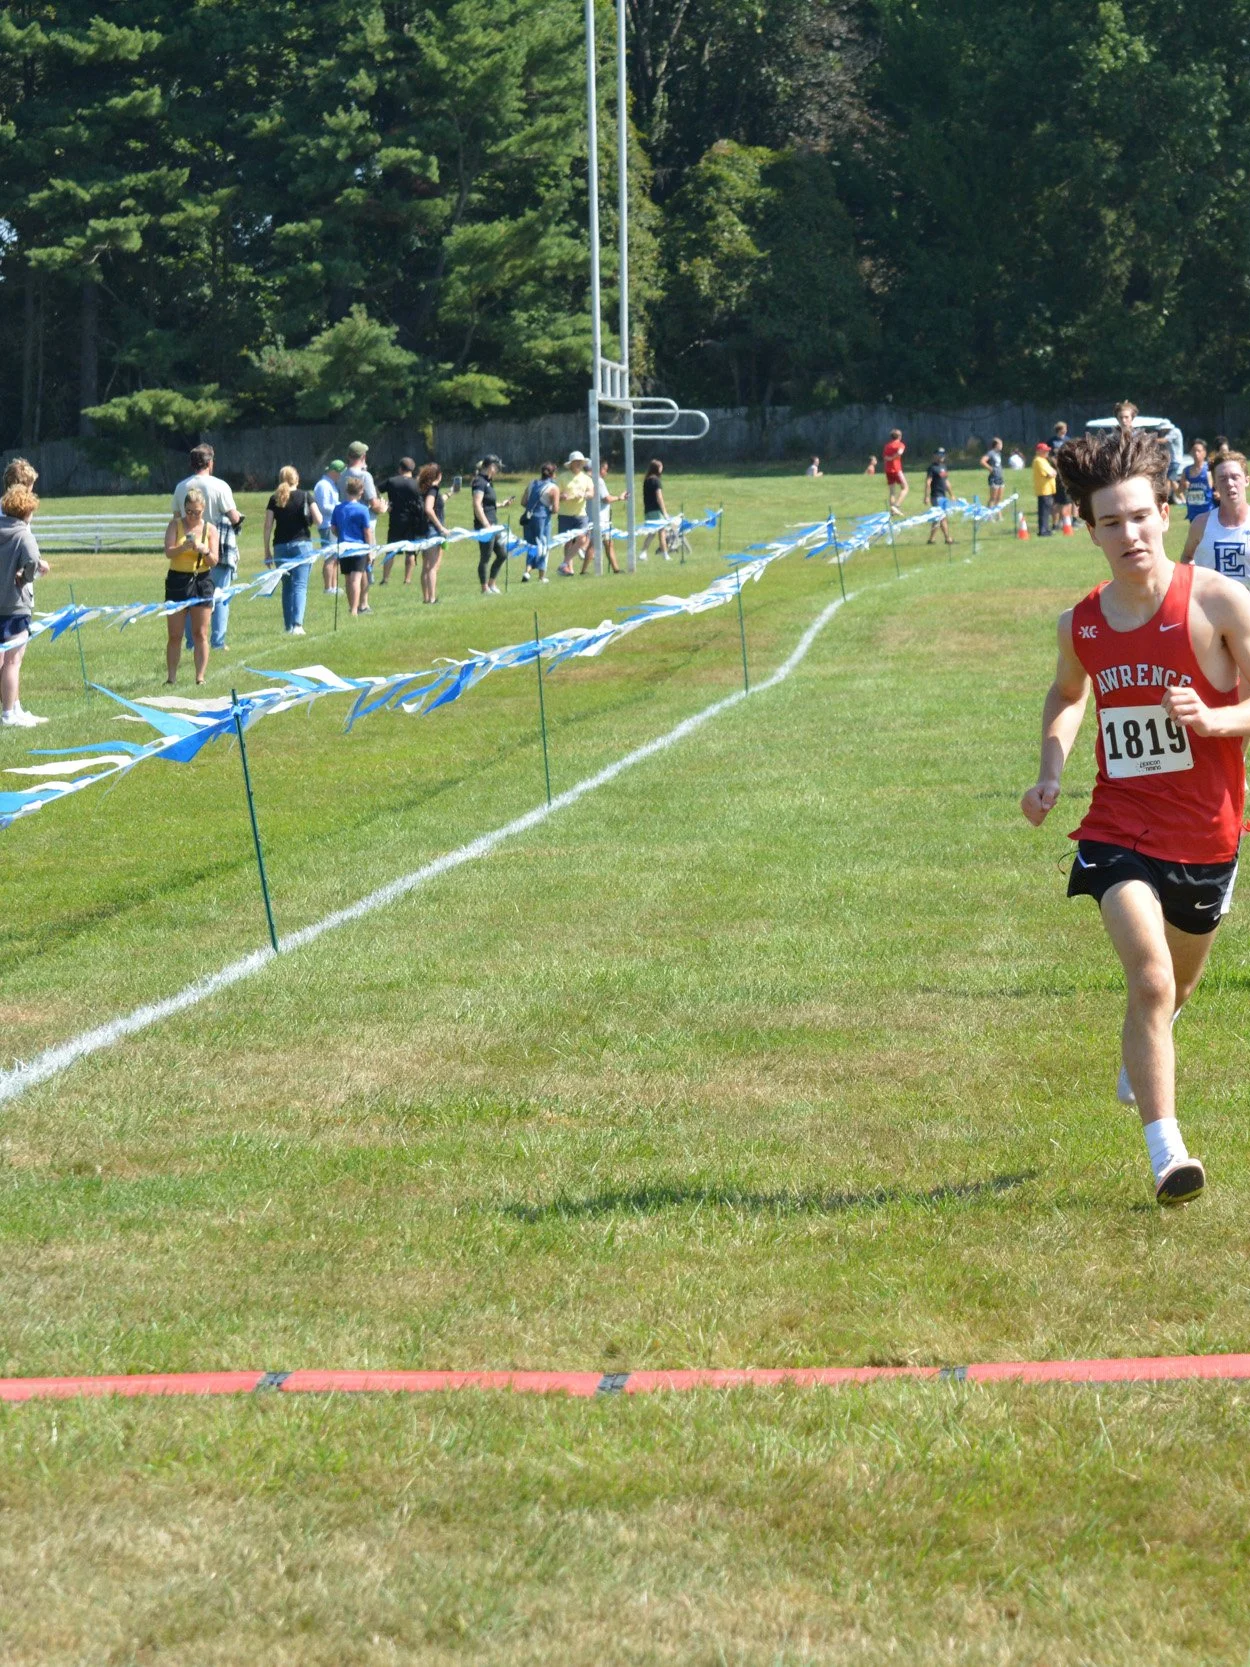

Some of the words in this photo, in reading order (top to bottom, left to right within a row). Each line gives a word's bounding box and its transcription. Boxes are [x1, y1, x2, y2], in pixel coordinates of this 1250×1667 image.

[1213, 541, 1245, 577] E
[1079, 625, 1098, 639] XC
[1105, 716, 1187, 760] 1819
